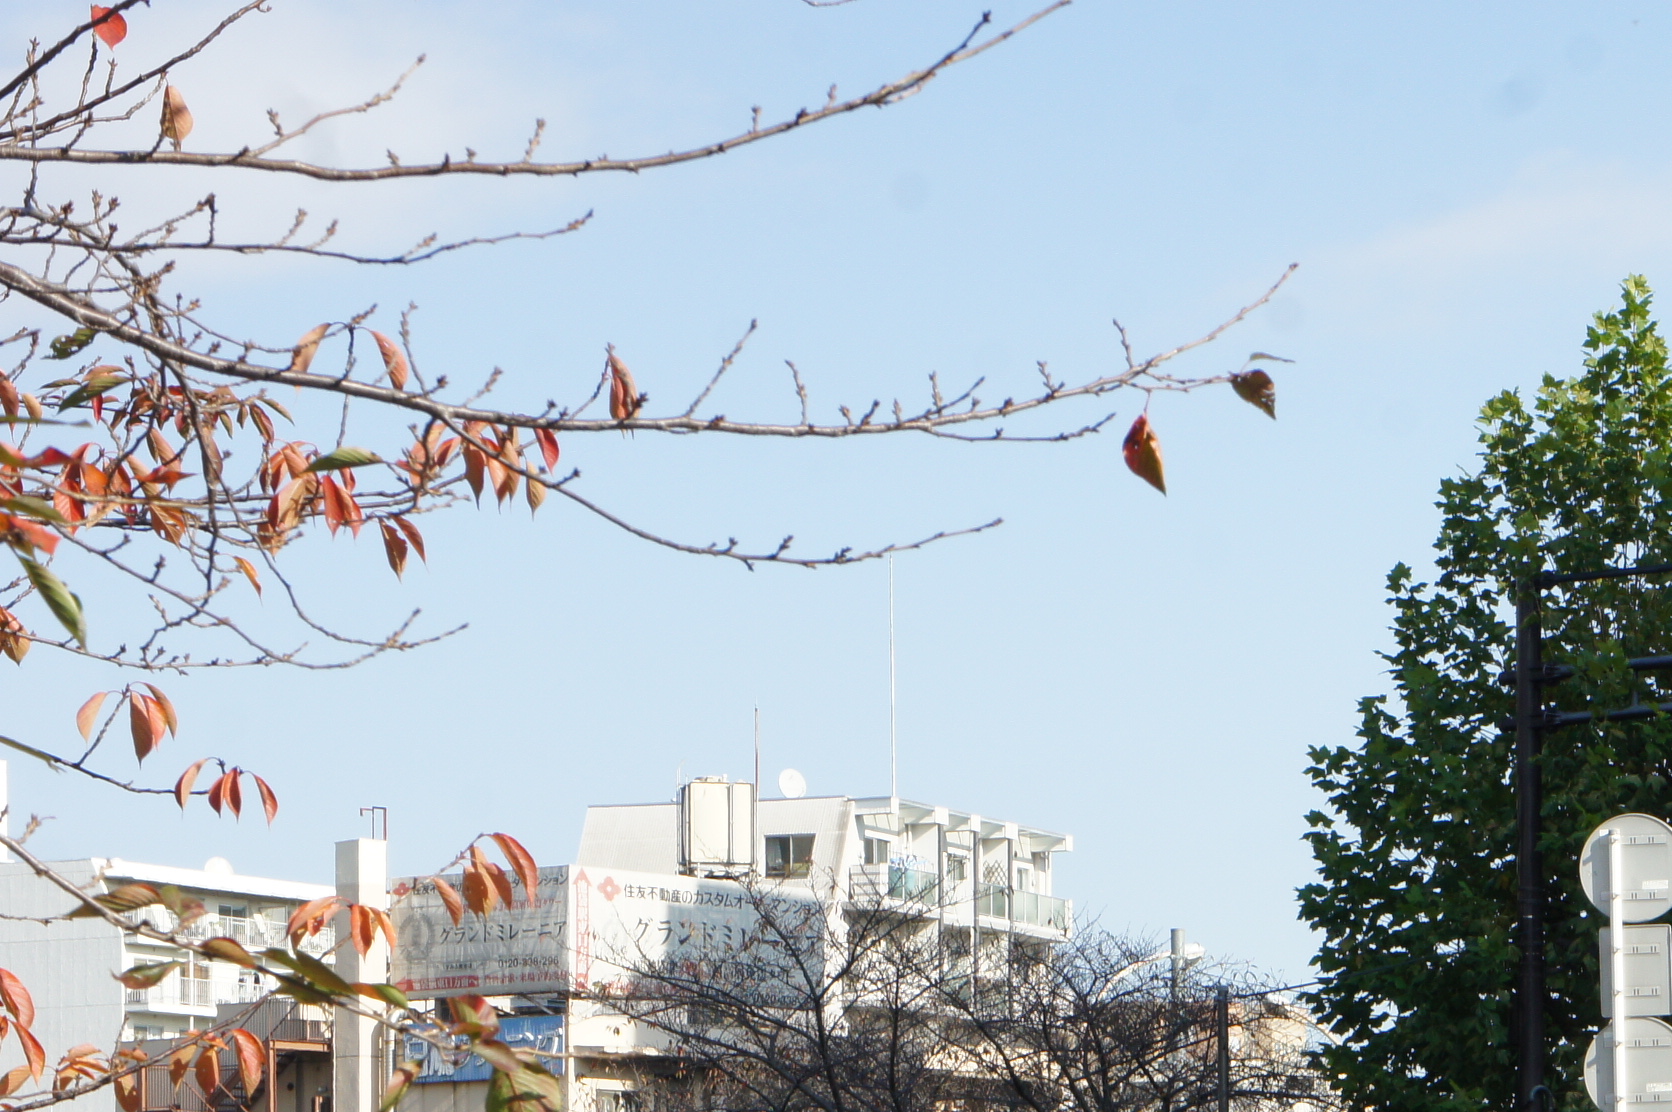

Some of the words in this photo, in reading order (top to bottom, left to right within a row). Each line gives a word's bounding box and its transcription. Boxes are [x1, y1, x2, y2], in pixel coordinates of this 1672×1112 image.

[624, 883, 821, 914] 住友不動産のカスタムオーーマンション
[440, 920, 567, 944] グランドミレーニア
